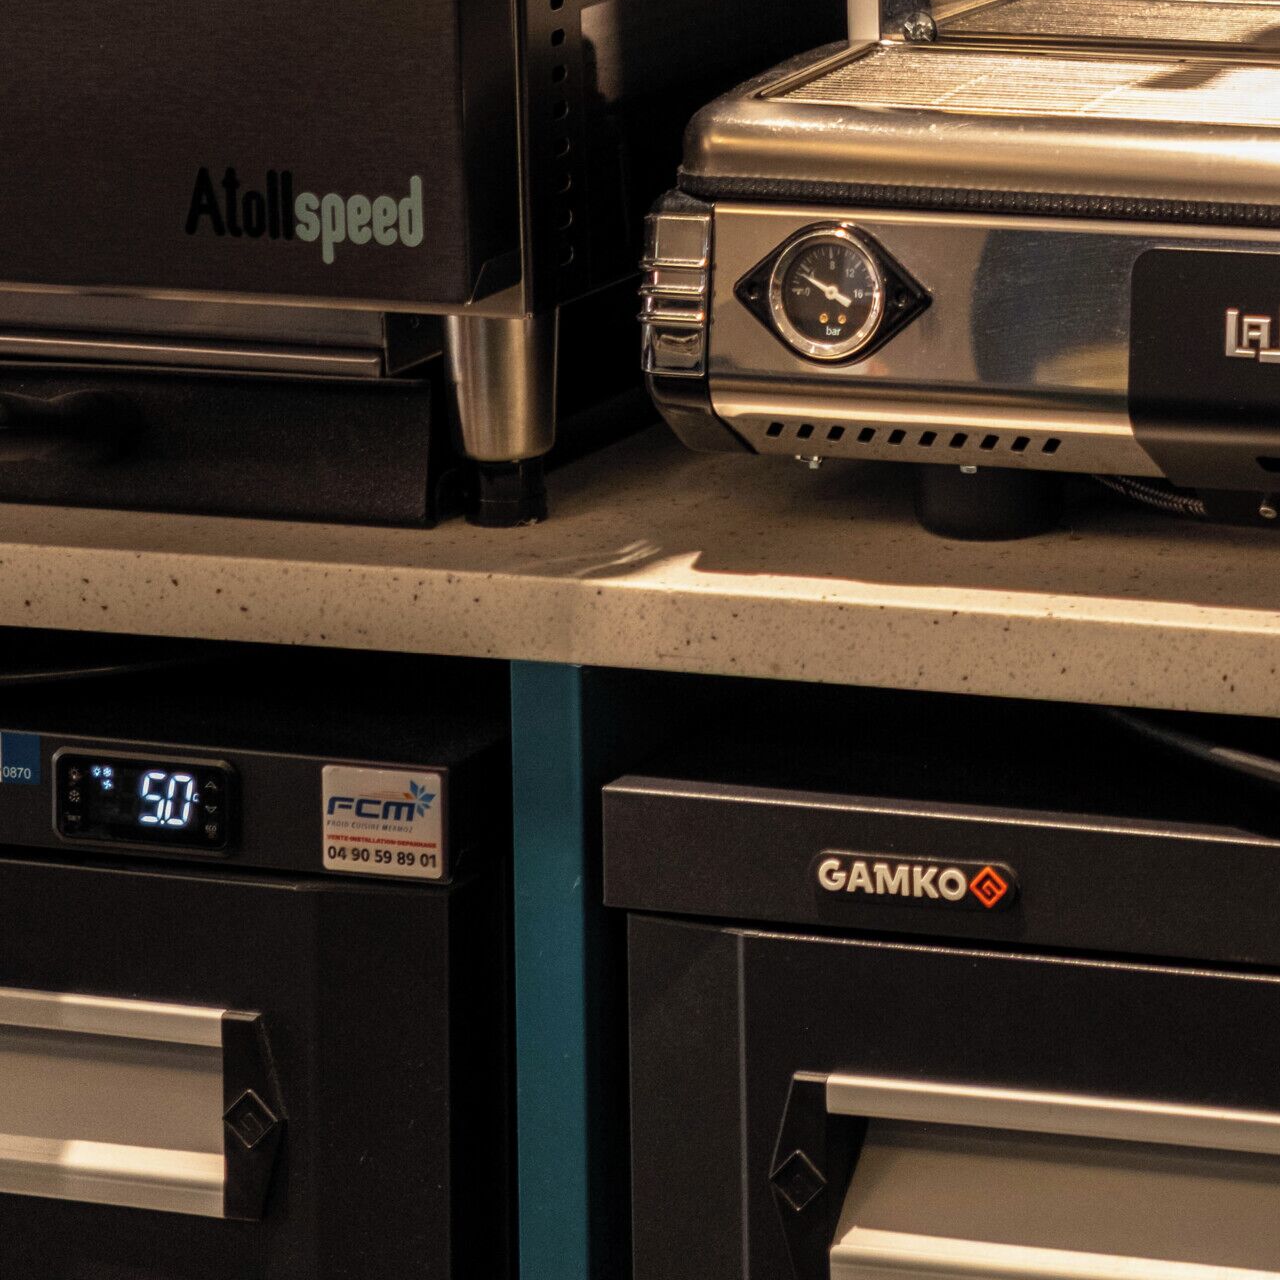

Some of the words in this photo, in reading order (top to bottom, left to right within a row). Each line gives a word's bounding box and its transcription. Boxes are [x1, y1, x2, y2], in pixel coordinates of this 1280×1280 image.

[845, 268, 855, 279] 12
[853, 289, 864, 299] 16
[825, 325, 841, 336] bar
[3, 766, 32, 780] 0870
[139, 771, 194, 826] 5.0
[327, 796, 416, 822] FCM
[328, 845, 347, 861] 04
[351, 848, 370, 862] 90
[374, 850, 392, 864] 59
[397, 851, 415, 866] 89
[420, 853, 437, 868] 01
[818, 857, 968, 902] GAMKO
